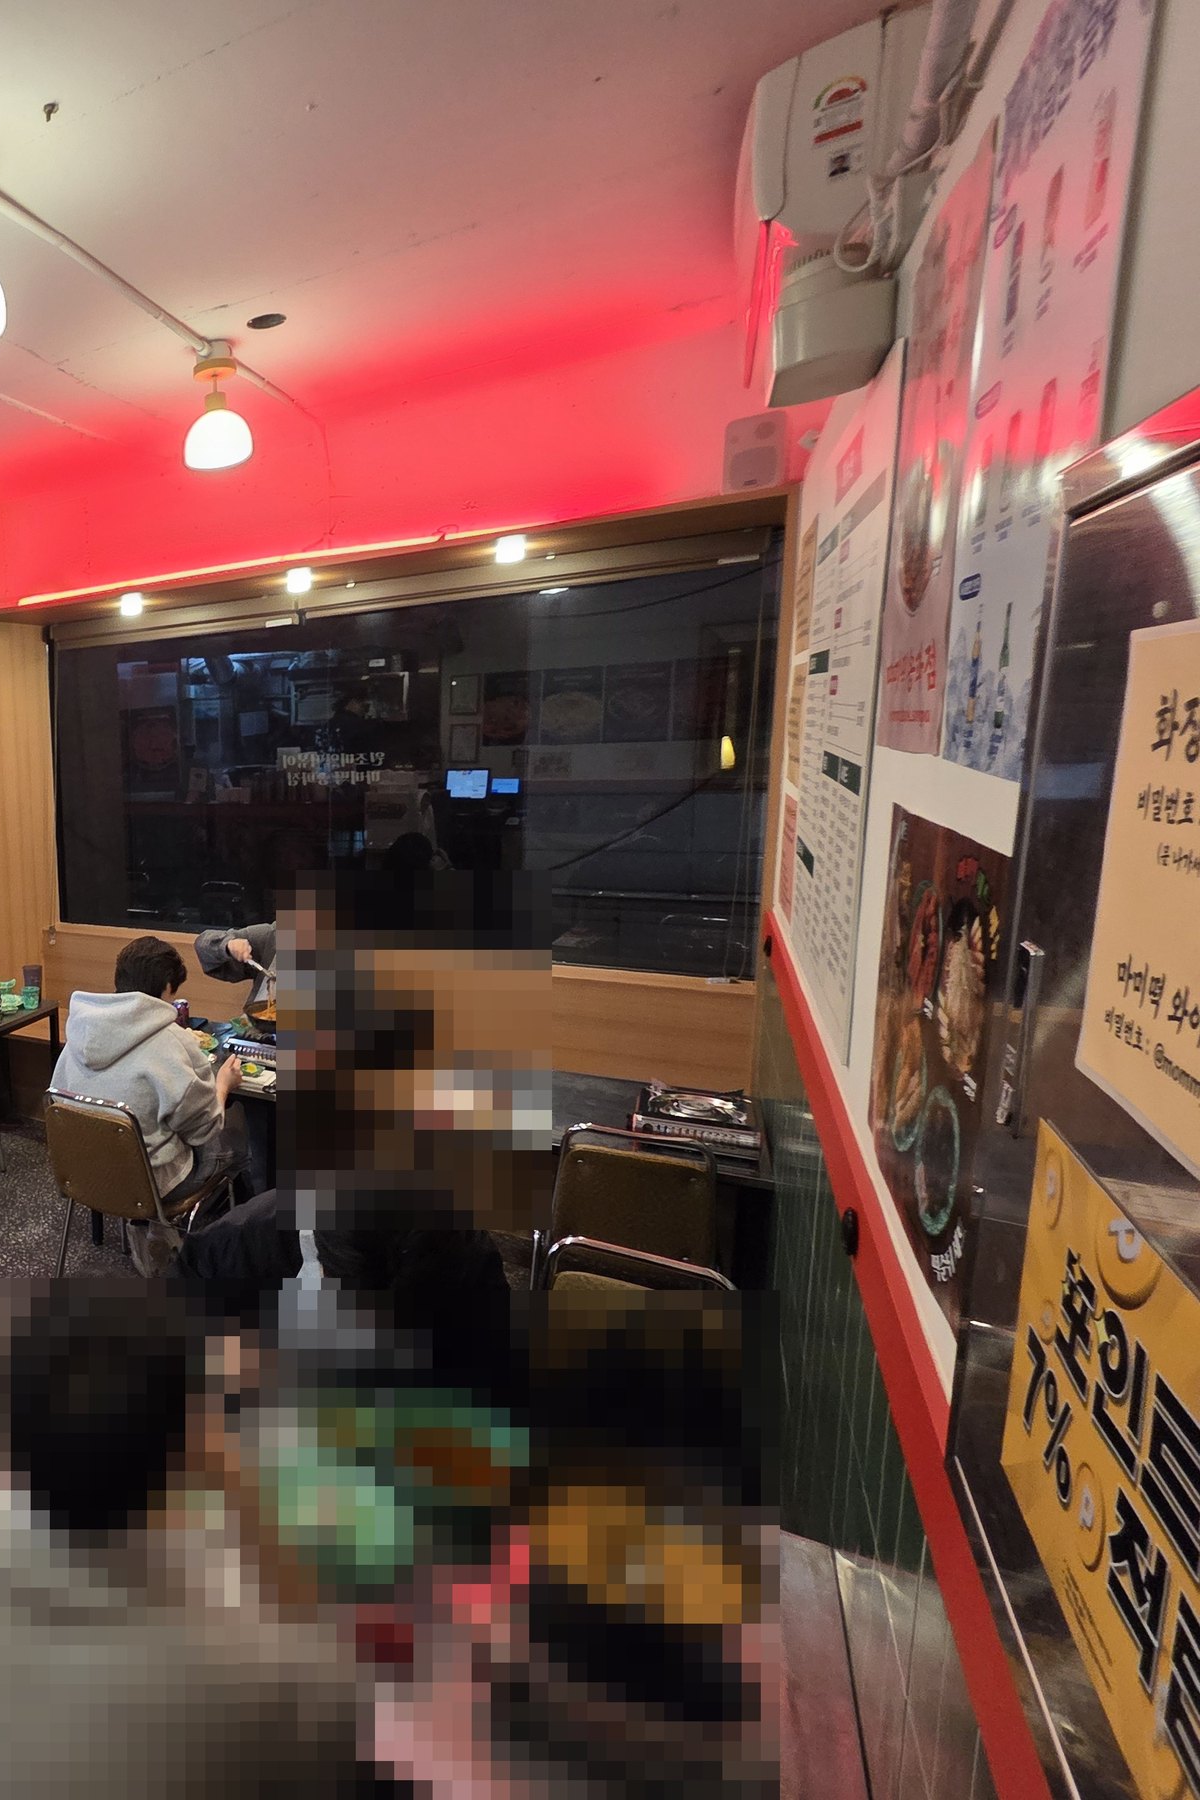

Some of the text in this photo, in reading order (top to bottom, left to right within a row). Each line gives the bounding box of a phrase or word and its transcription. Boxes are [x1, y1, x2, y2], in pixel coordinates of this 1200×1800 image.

[1137, 783, 1194, 825] 비밀번호
[1116, 953, 1166, 1020] 마미떡
[1104, 1006, 1144, 1052] 비밀번호
[1022, 1321, 1073, 1510] 7%
